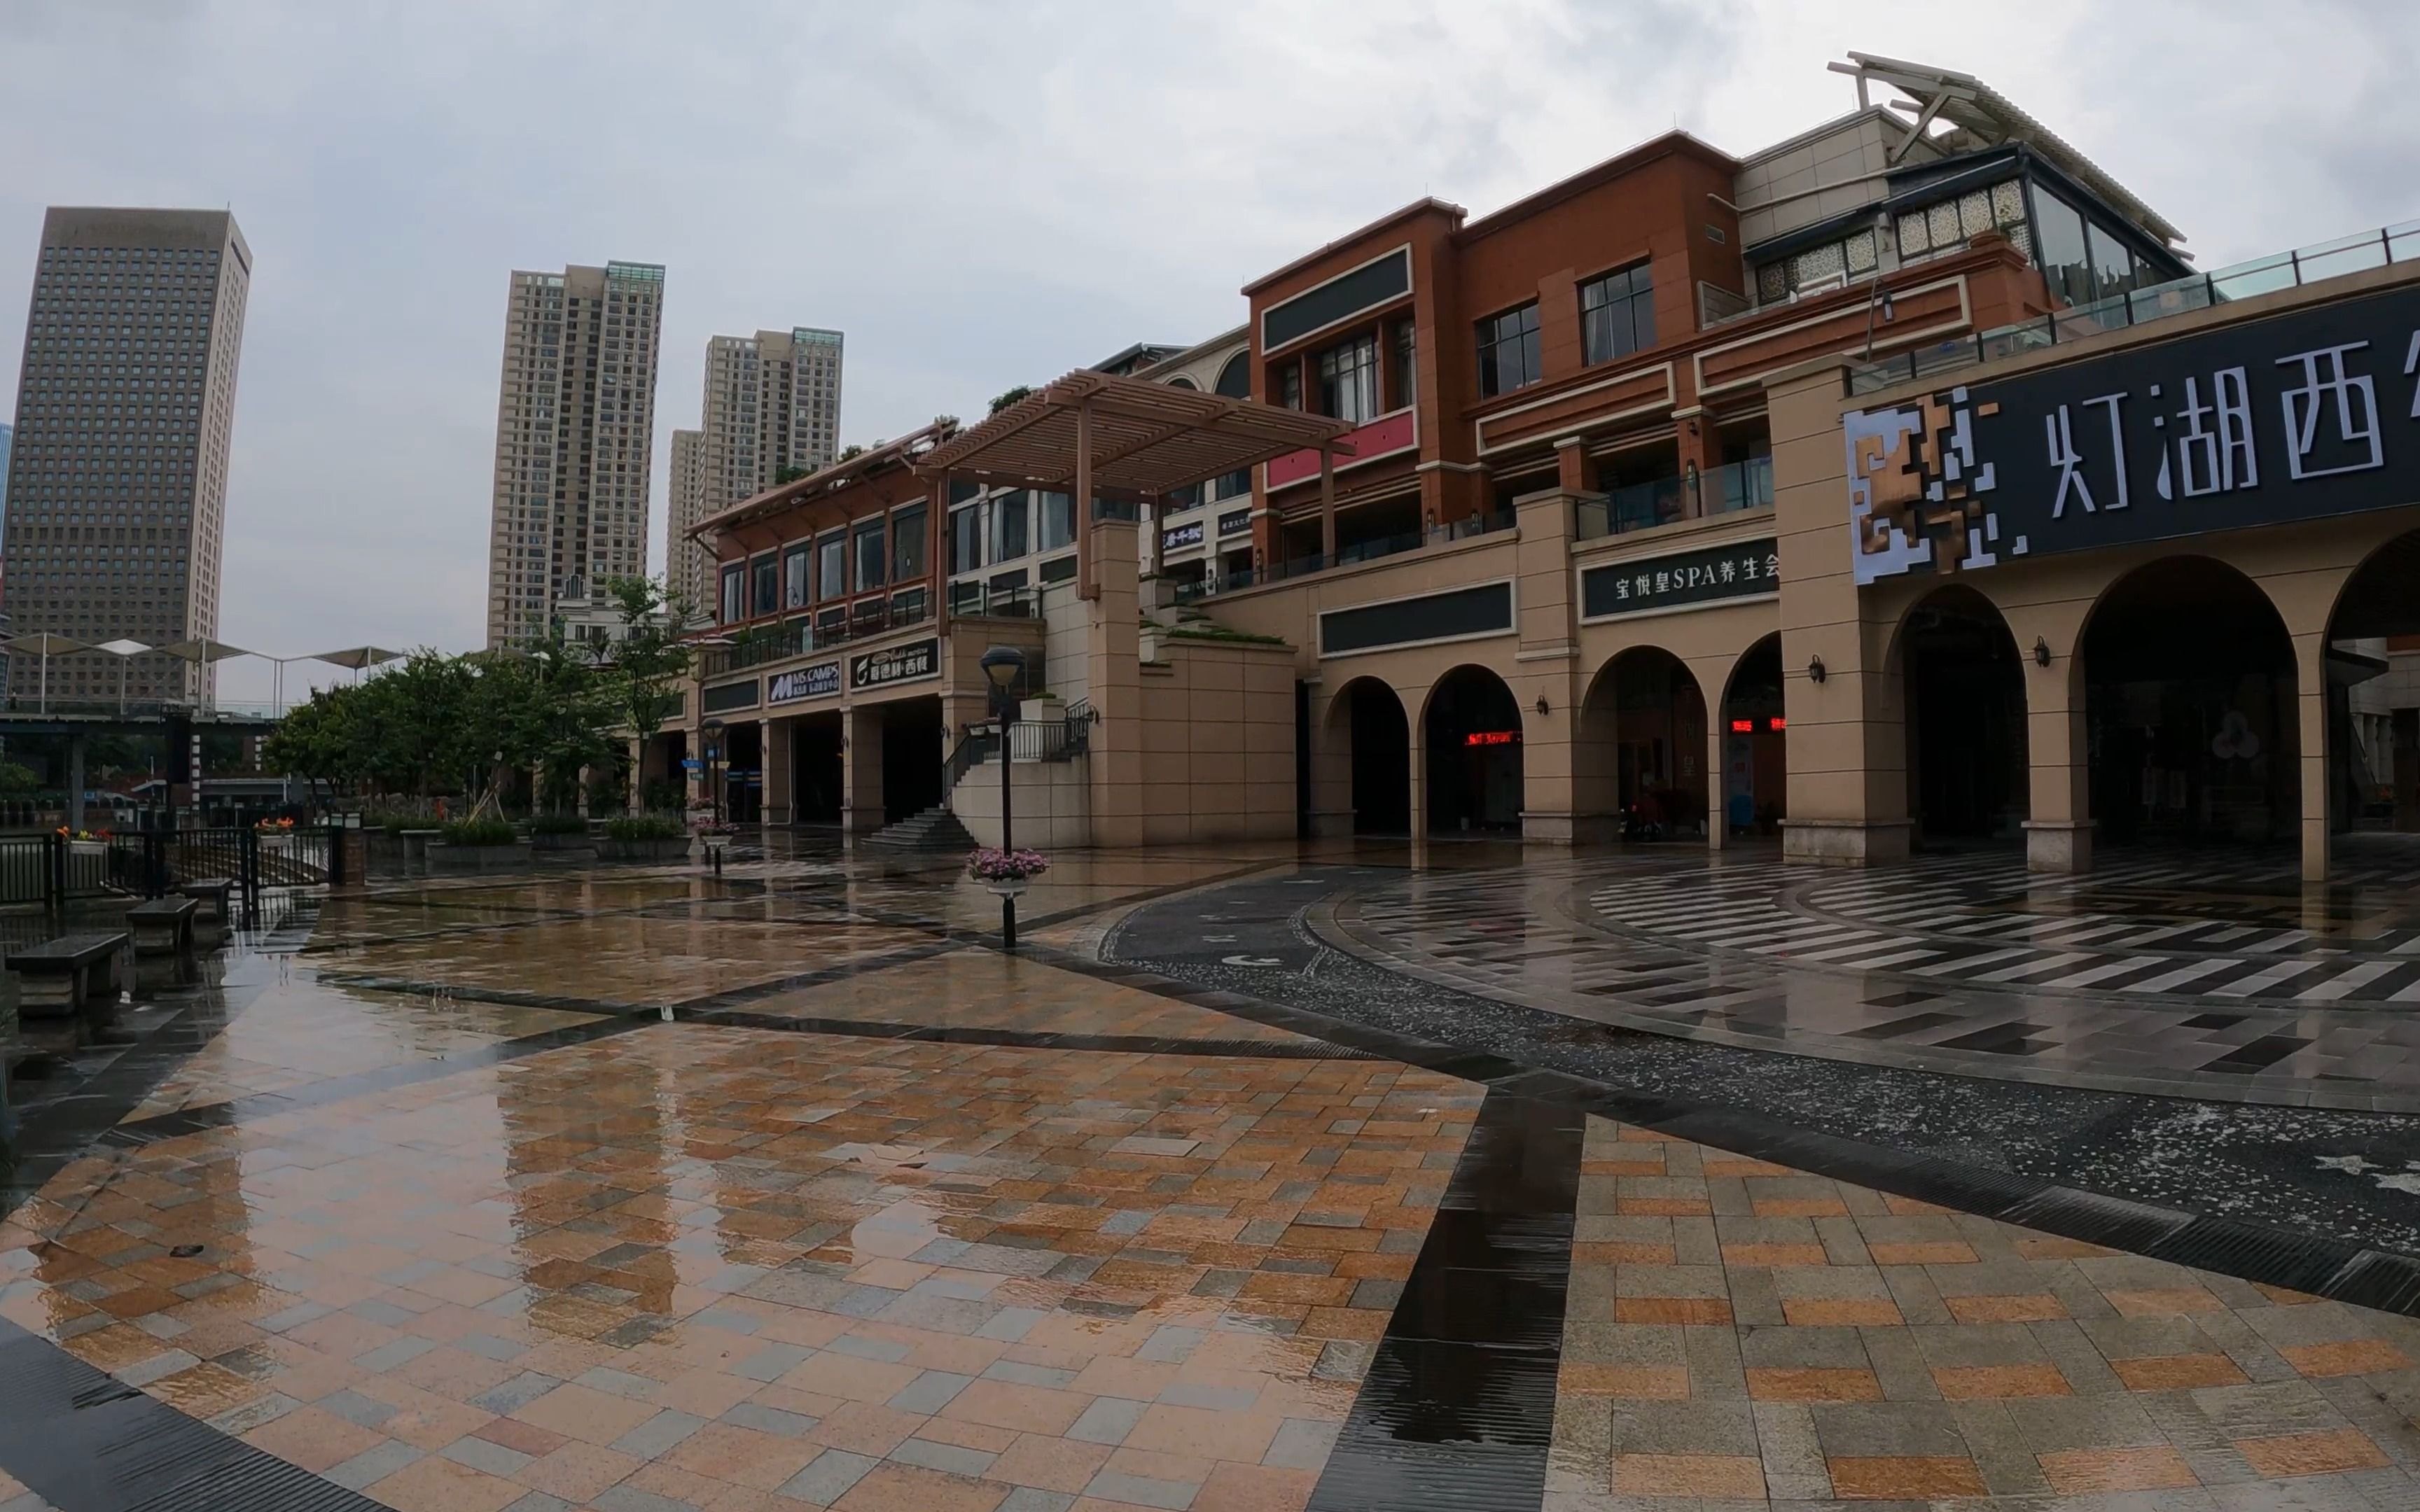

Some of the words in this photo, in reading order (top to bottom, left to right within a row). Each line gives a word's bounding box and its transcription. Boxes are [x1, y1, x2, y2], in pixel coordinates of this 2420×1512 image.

[2046, 329, 2420, 519] 灯湖西
[1615, 554, 1780, 600] 宝悦皇SPA养生会
